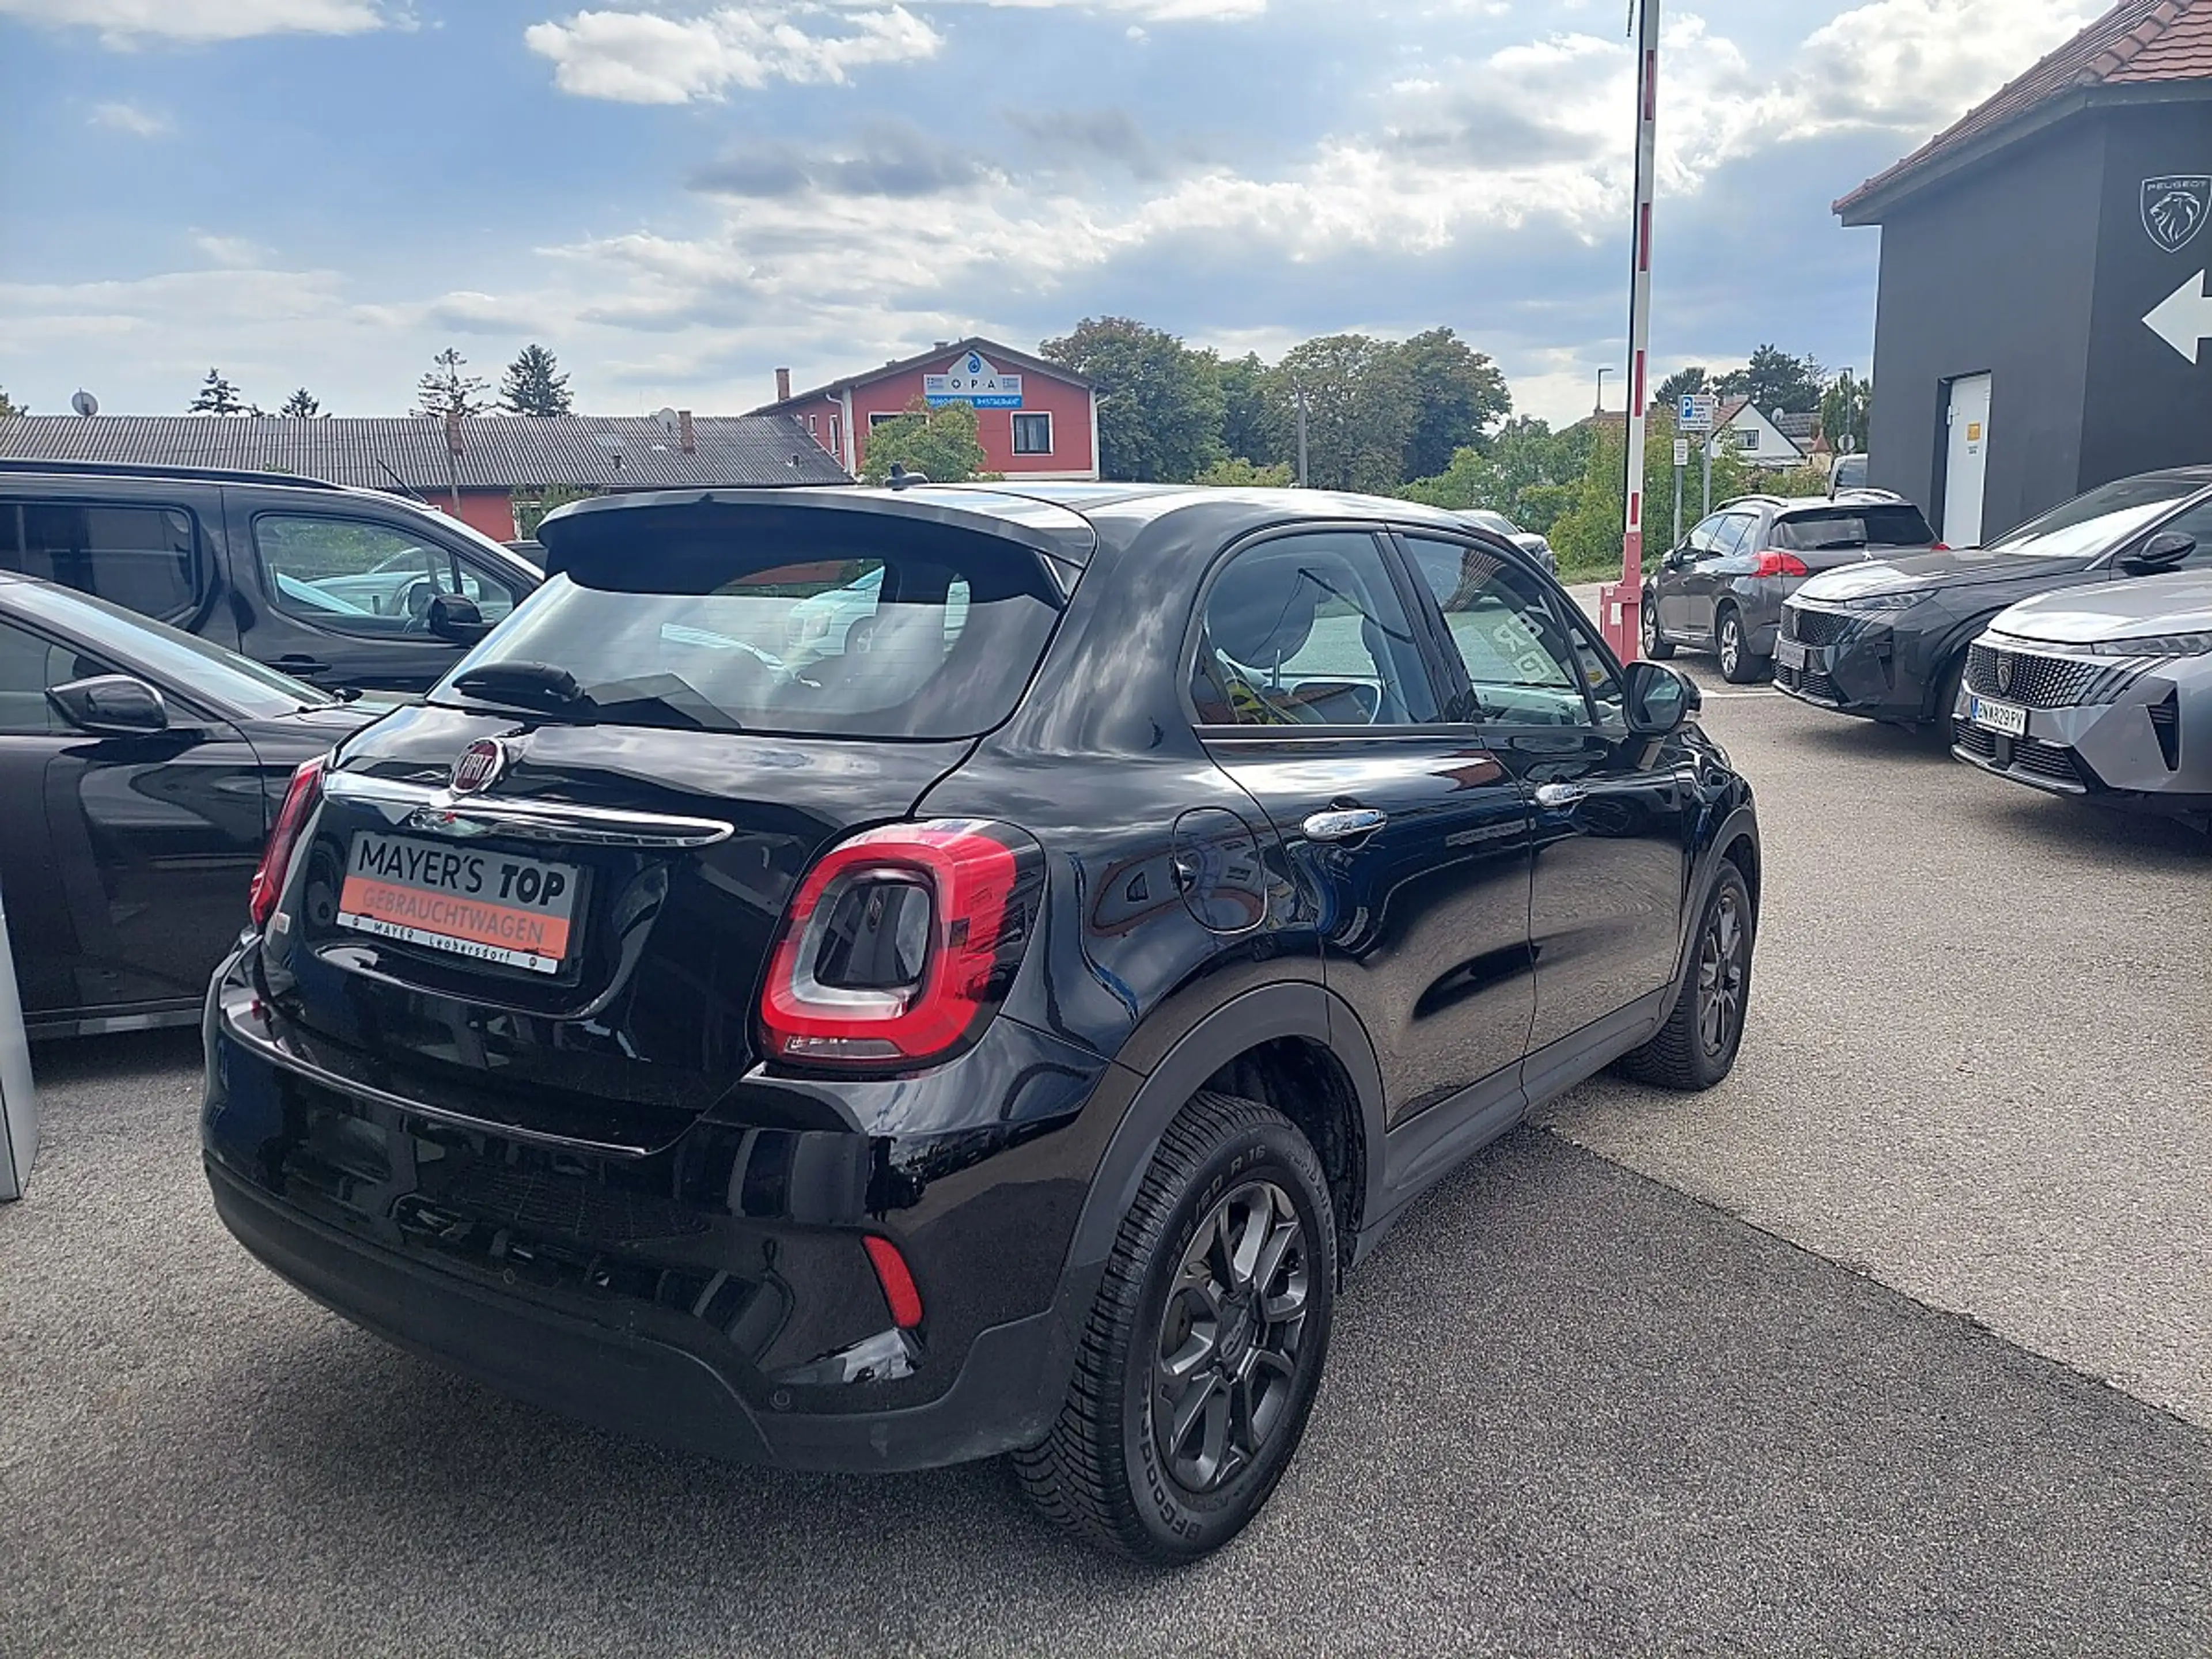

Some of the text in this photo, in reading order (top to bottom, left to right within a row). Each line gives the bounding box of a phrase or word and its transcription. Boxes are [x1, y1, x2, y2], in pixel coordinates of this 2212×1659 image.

[2147, 180, 2206, 191] PEUGEOT
[1683, 399, 1692, 416] P
[460, 753, 494, 781] FIAT
[358, 839, 565, 906] MAYER'S TOP
[363, 887, 544, 945] GEBRAUCHTWAGEN
[374, 922, 511, 961] MAYER Leobersdorf
